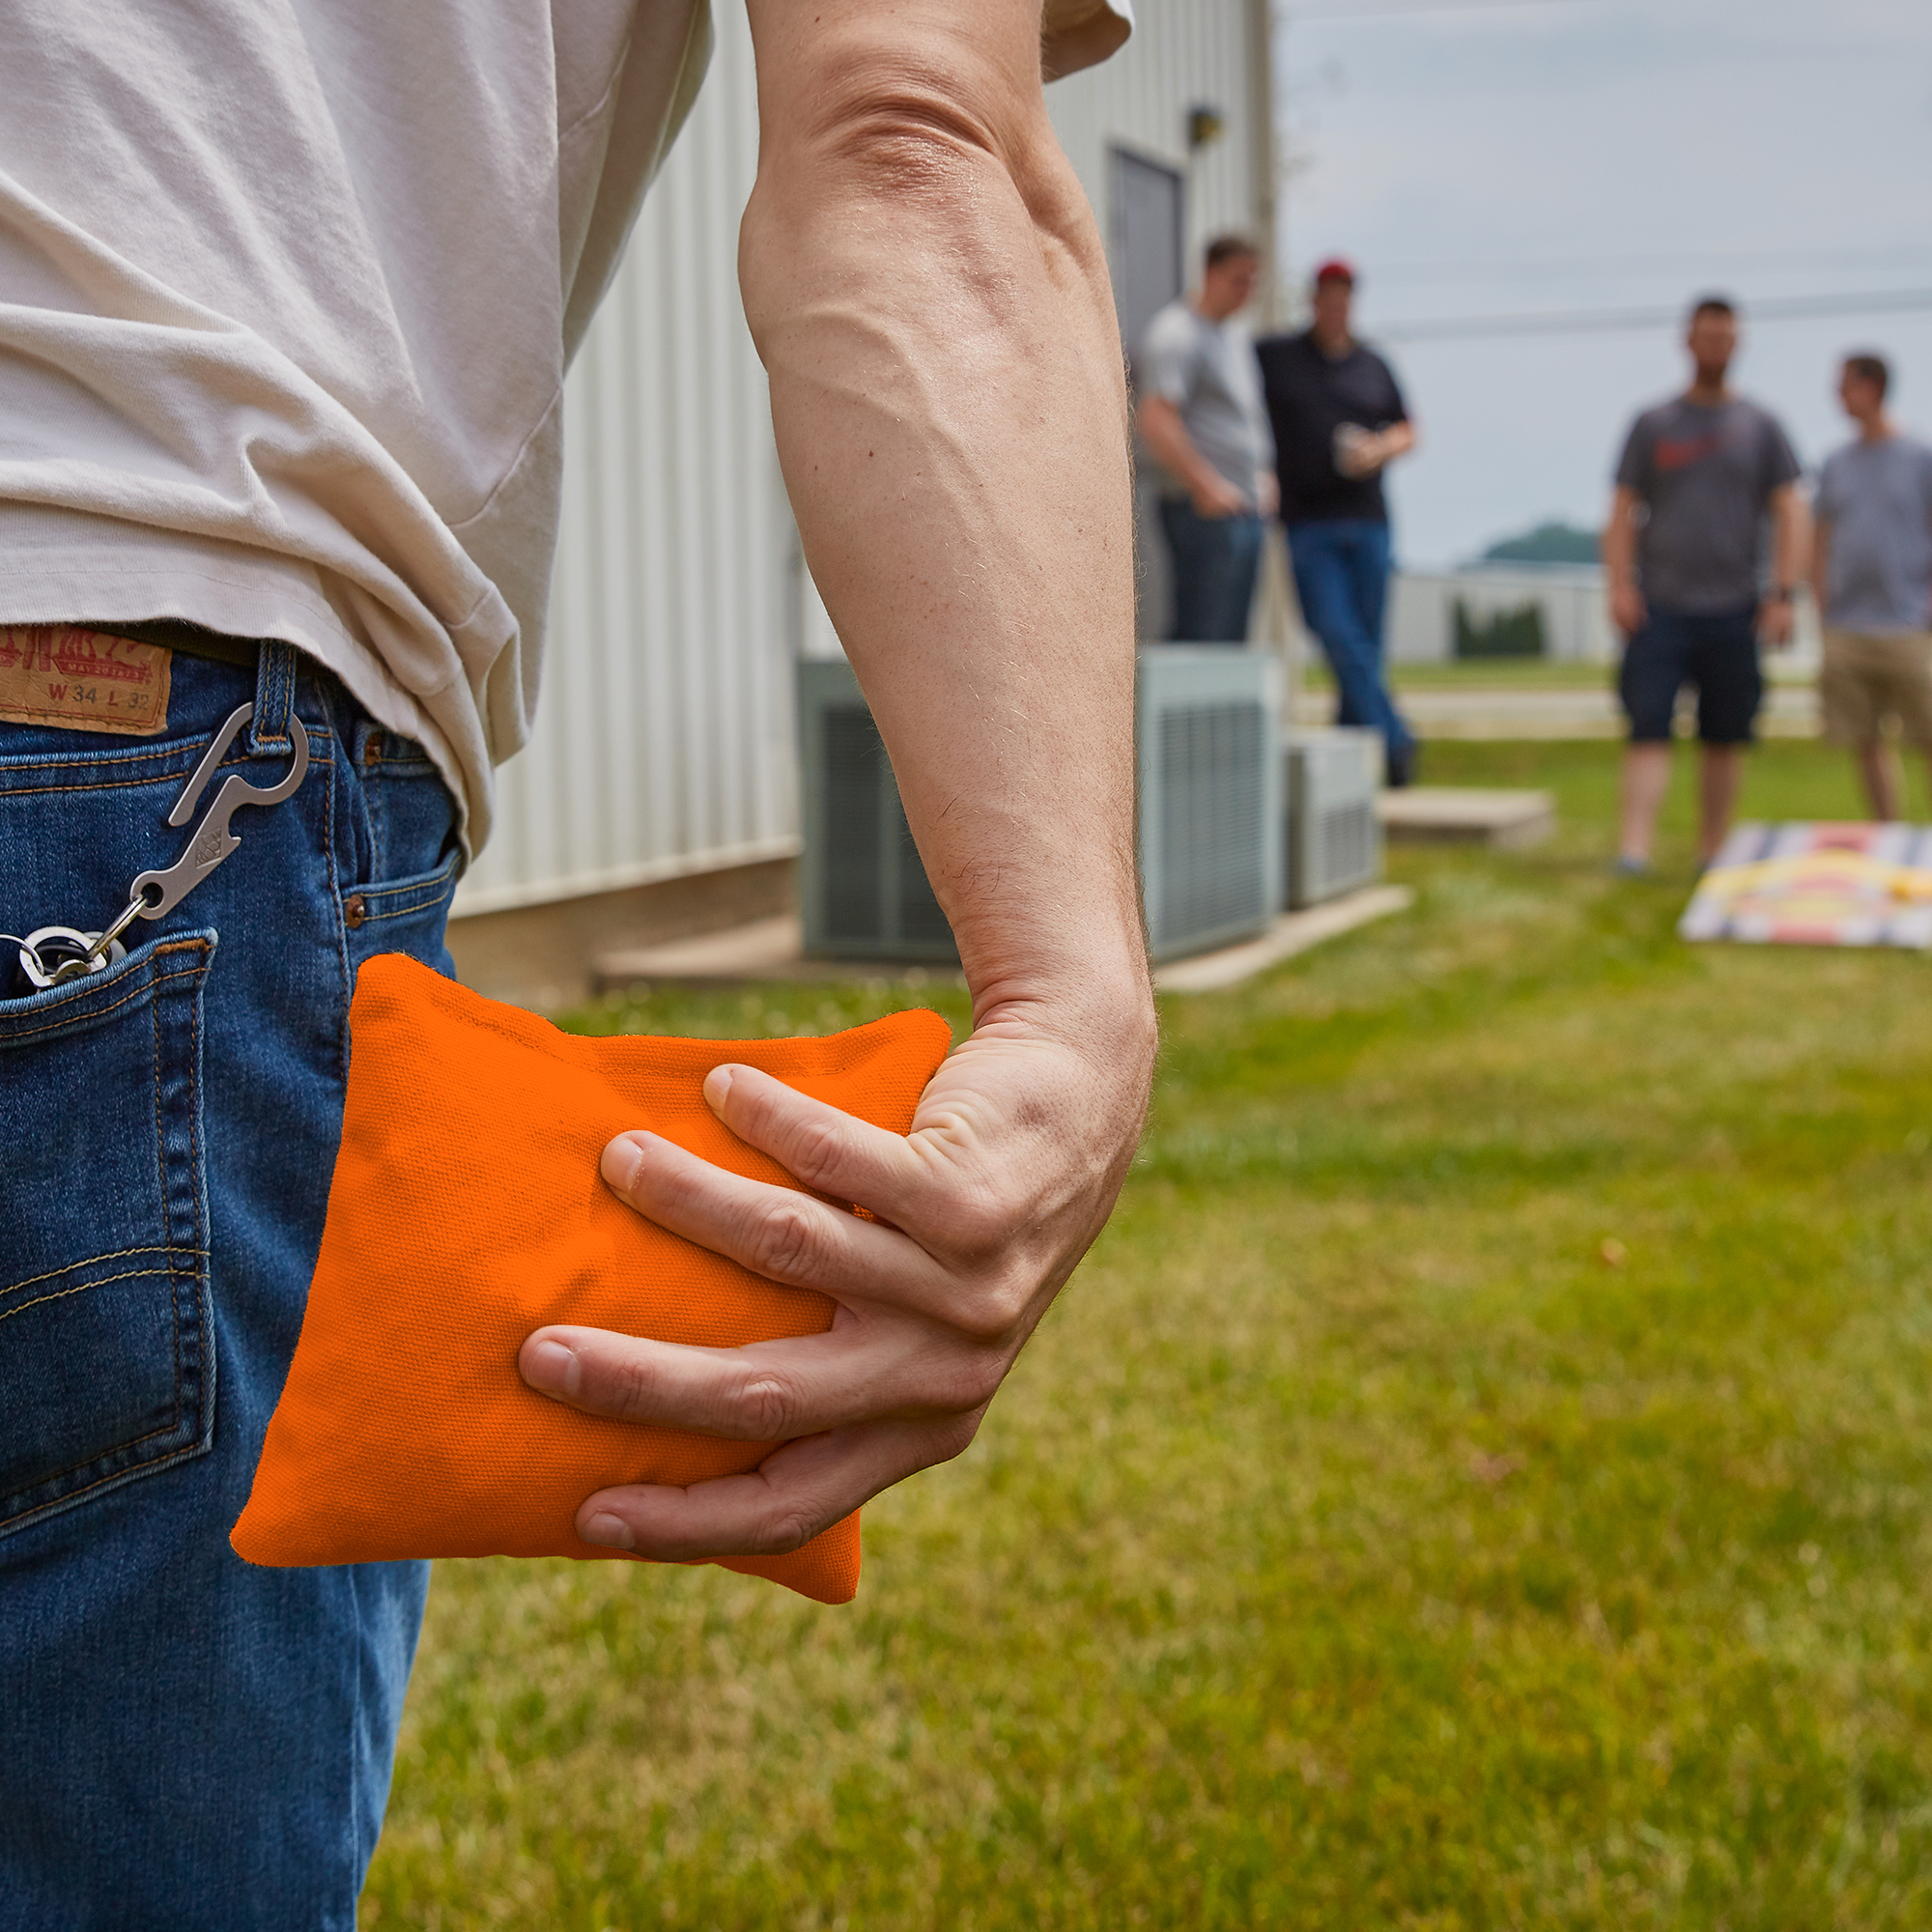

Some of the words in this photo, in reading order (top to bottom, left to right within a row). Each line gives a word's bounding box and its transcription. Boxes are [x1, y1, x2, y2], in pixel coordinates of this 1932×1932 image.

[68, 663, 90, 673] MAY
[48, 683, 68, 700] W
[72, 684, 97, 704] 34
[108, 691, 119, 707] L
[128, 692, 150, 711] 32
